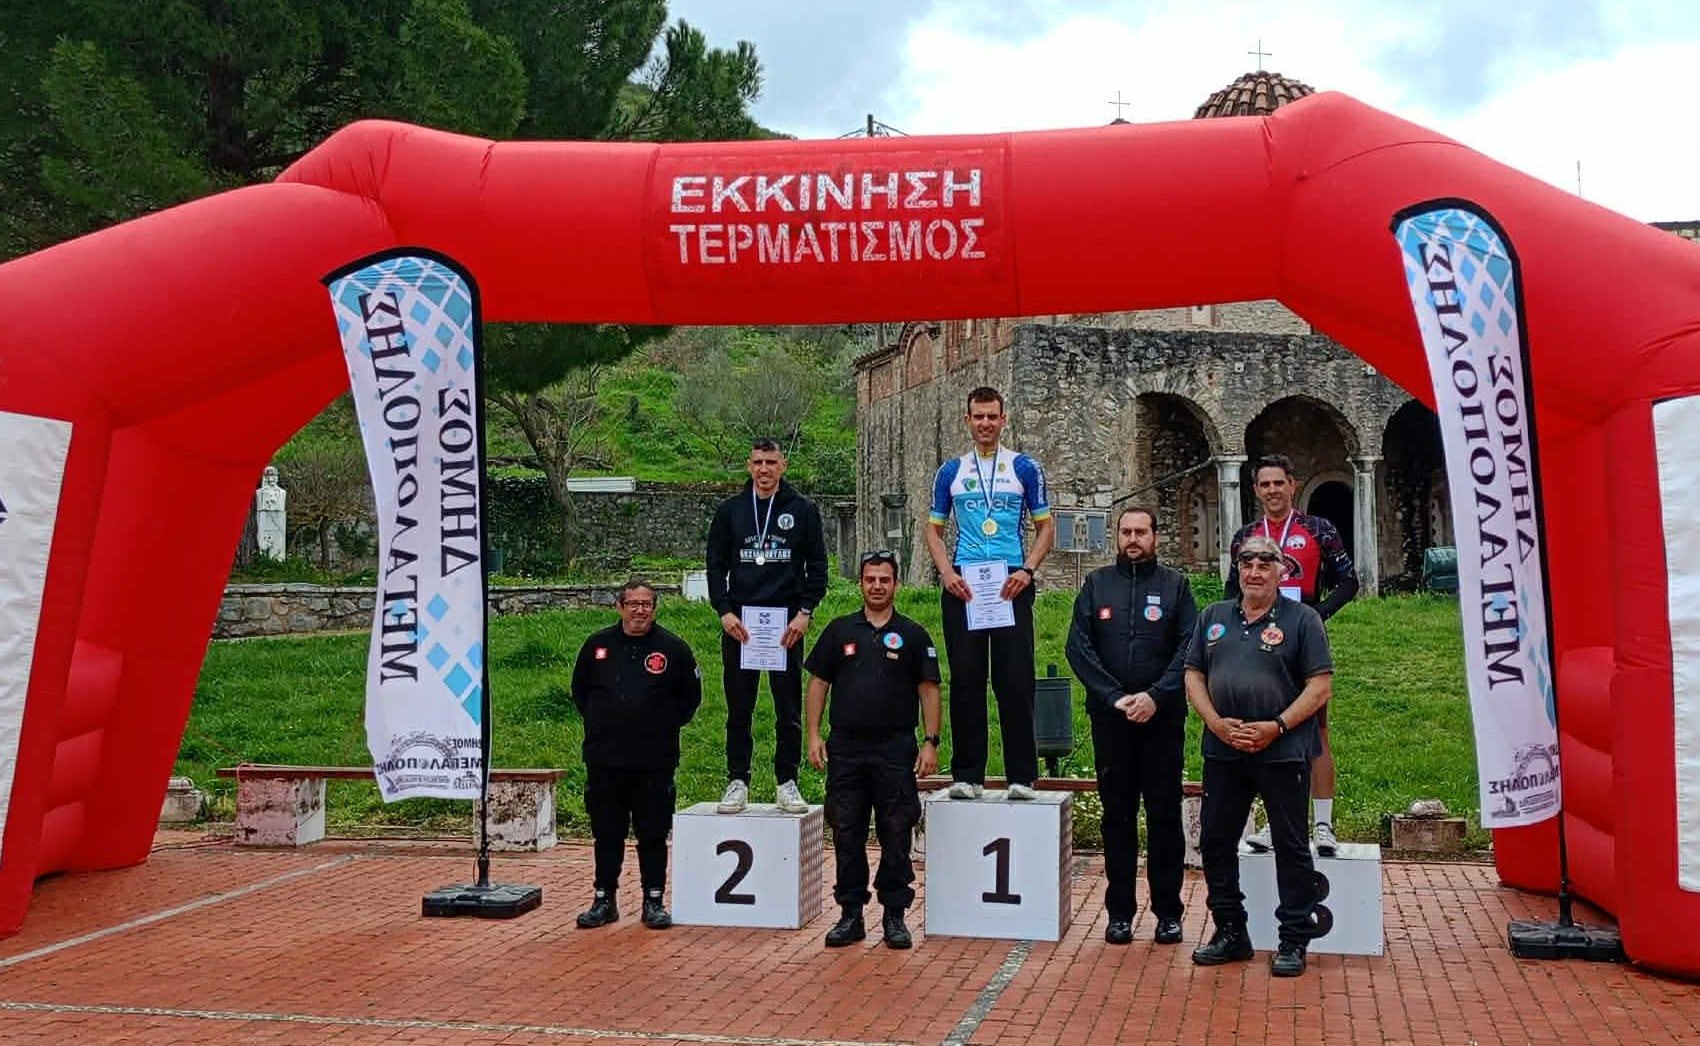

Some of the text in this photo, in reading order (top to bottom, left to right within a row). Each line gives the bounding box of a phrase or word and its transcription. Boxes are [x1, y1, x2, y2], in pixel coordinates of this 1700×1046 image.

[670, 169, 982, 213] ΕΚΚΙΝΗΣΗ
[669, 217, 987, 264] ΤΕΡΜΑΤΙΣΜΟΣ
[714, 839, 756, 906] 2
[981, 837, 1022, 906] 1
